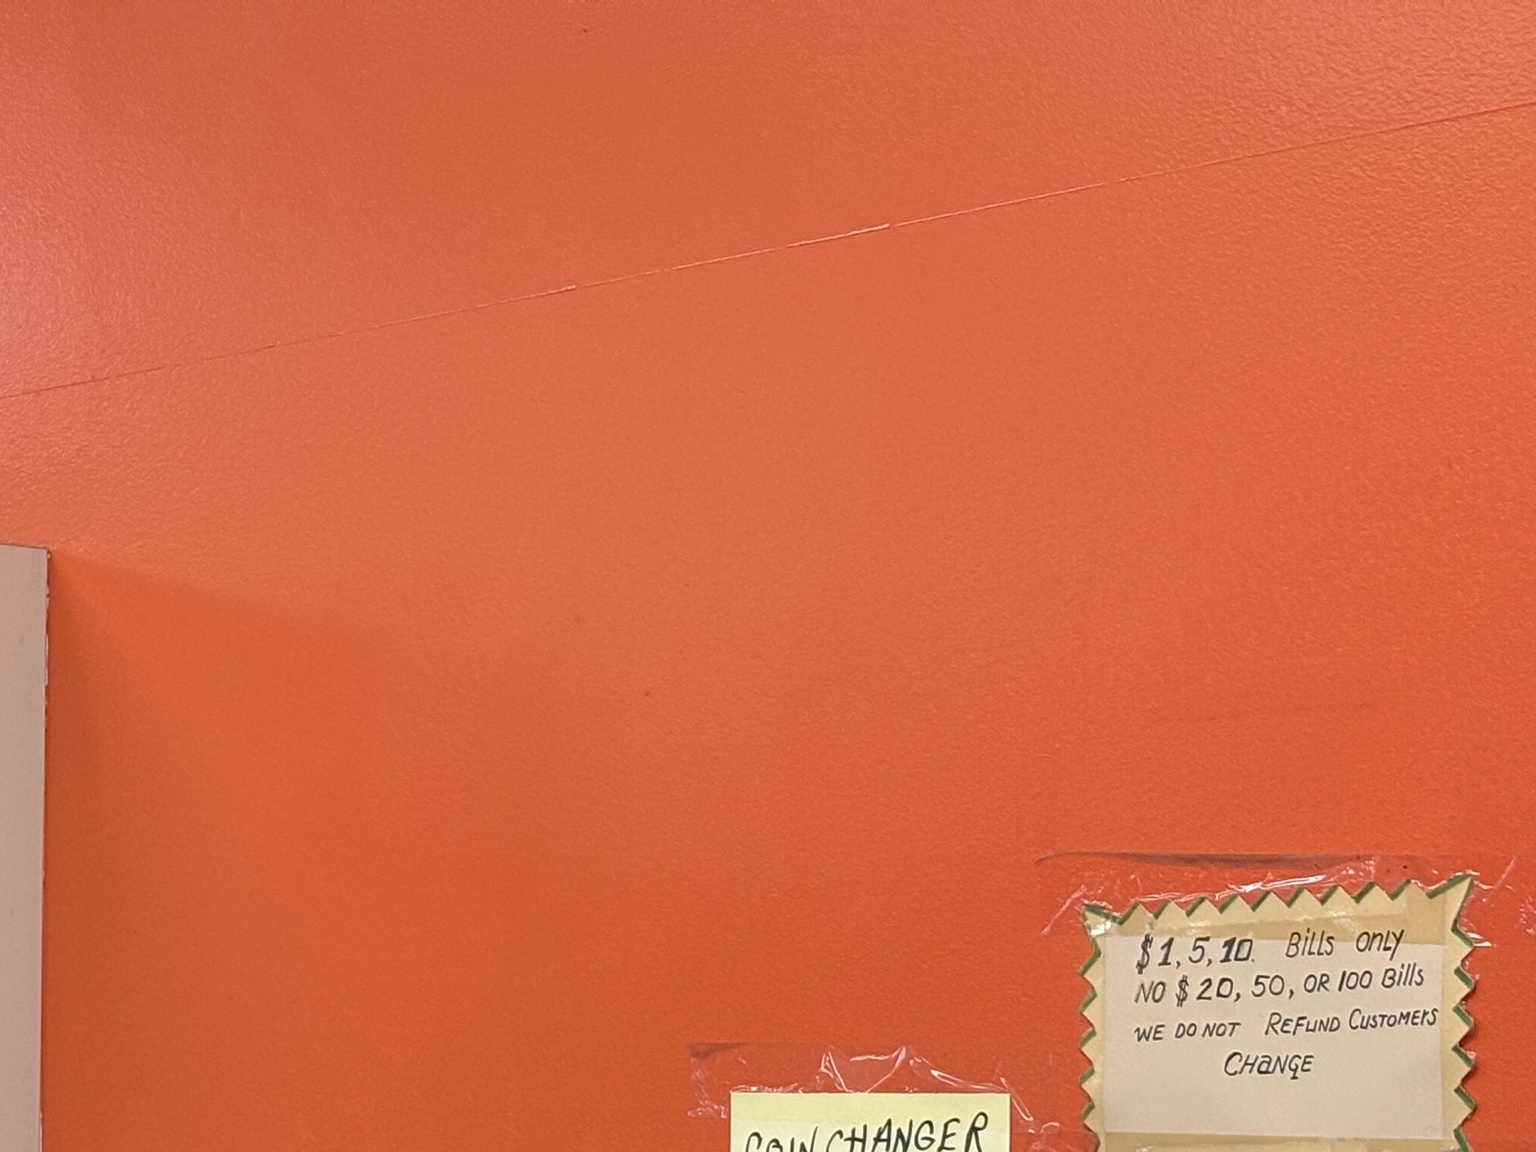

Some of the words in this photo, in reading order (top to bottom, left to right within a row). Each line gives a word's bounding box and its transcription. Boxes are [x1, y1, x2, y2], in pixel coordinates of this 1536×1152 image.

[1134, 980, 1167, 1004] NO
[1251, 974, 1295, 1000] 50,
[1303, 972, 1331, 993] OR
[1337, 970, 1373, 992] 100
[1381, 962, 1425, 989] Bills
[1133, 1024, 1166, 1042] WE
[1174, 1022, 1198, 1039] DO
[1201, 1022, 1242, 1038] NOT
